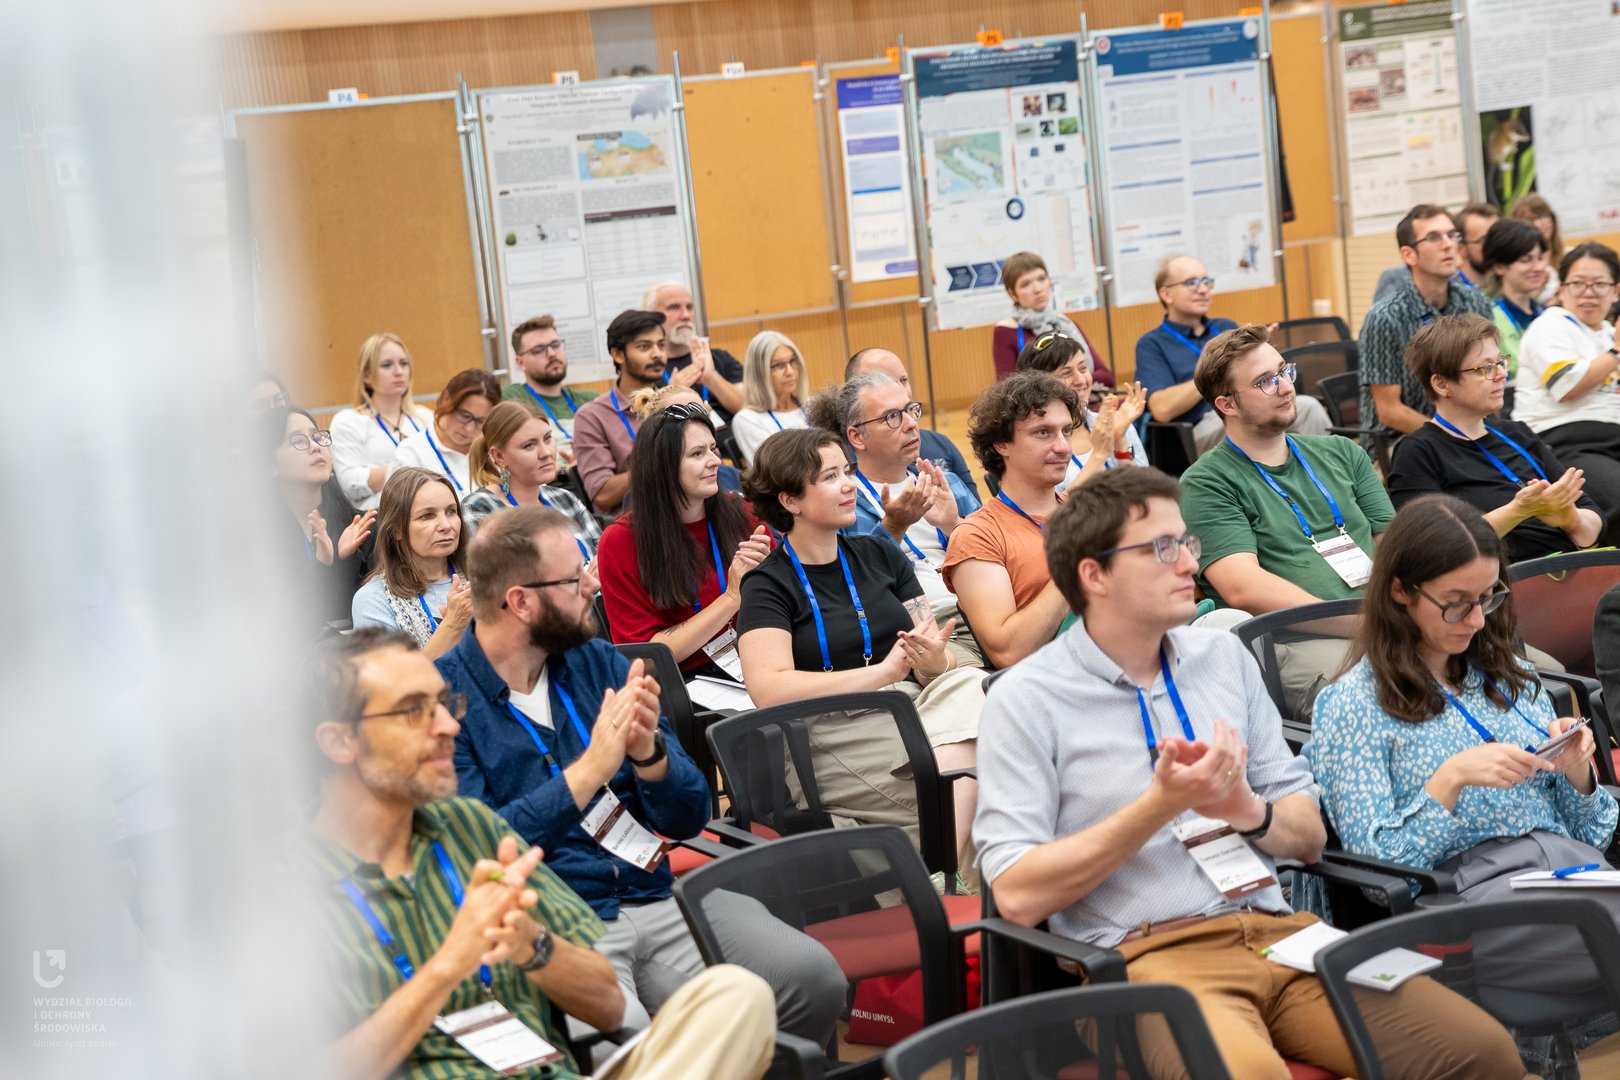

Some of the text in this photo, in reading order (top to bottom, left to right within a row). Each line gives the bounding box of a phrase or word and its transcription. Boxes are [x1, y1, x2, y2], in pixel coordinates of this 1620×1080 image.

[562, 75, 575, 85] P5
[338, 93, 352, 104] P4
[872, 1012, 895, 1024] UMYSŁ
